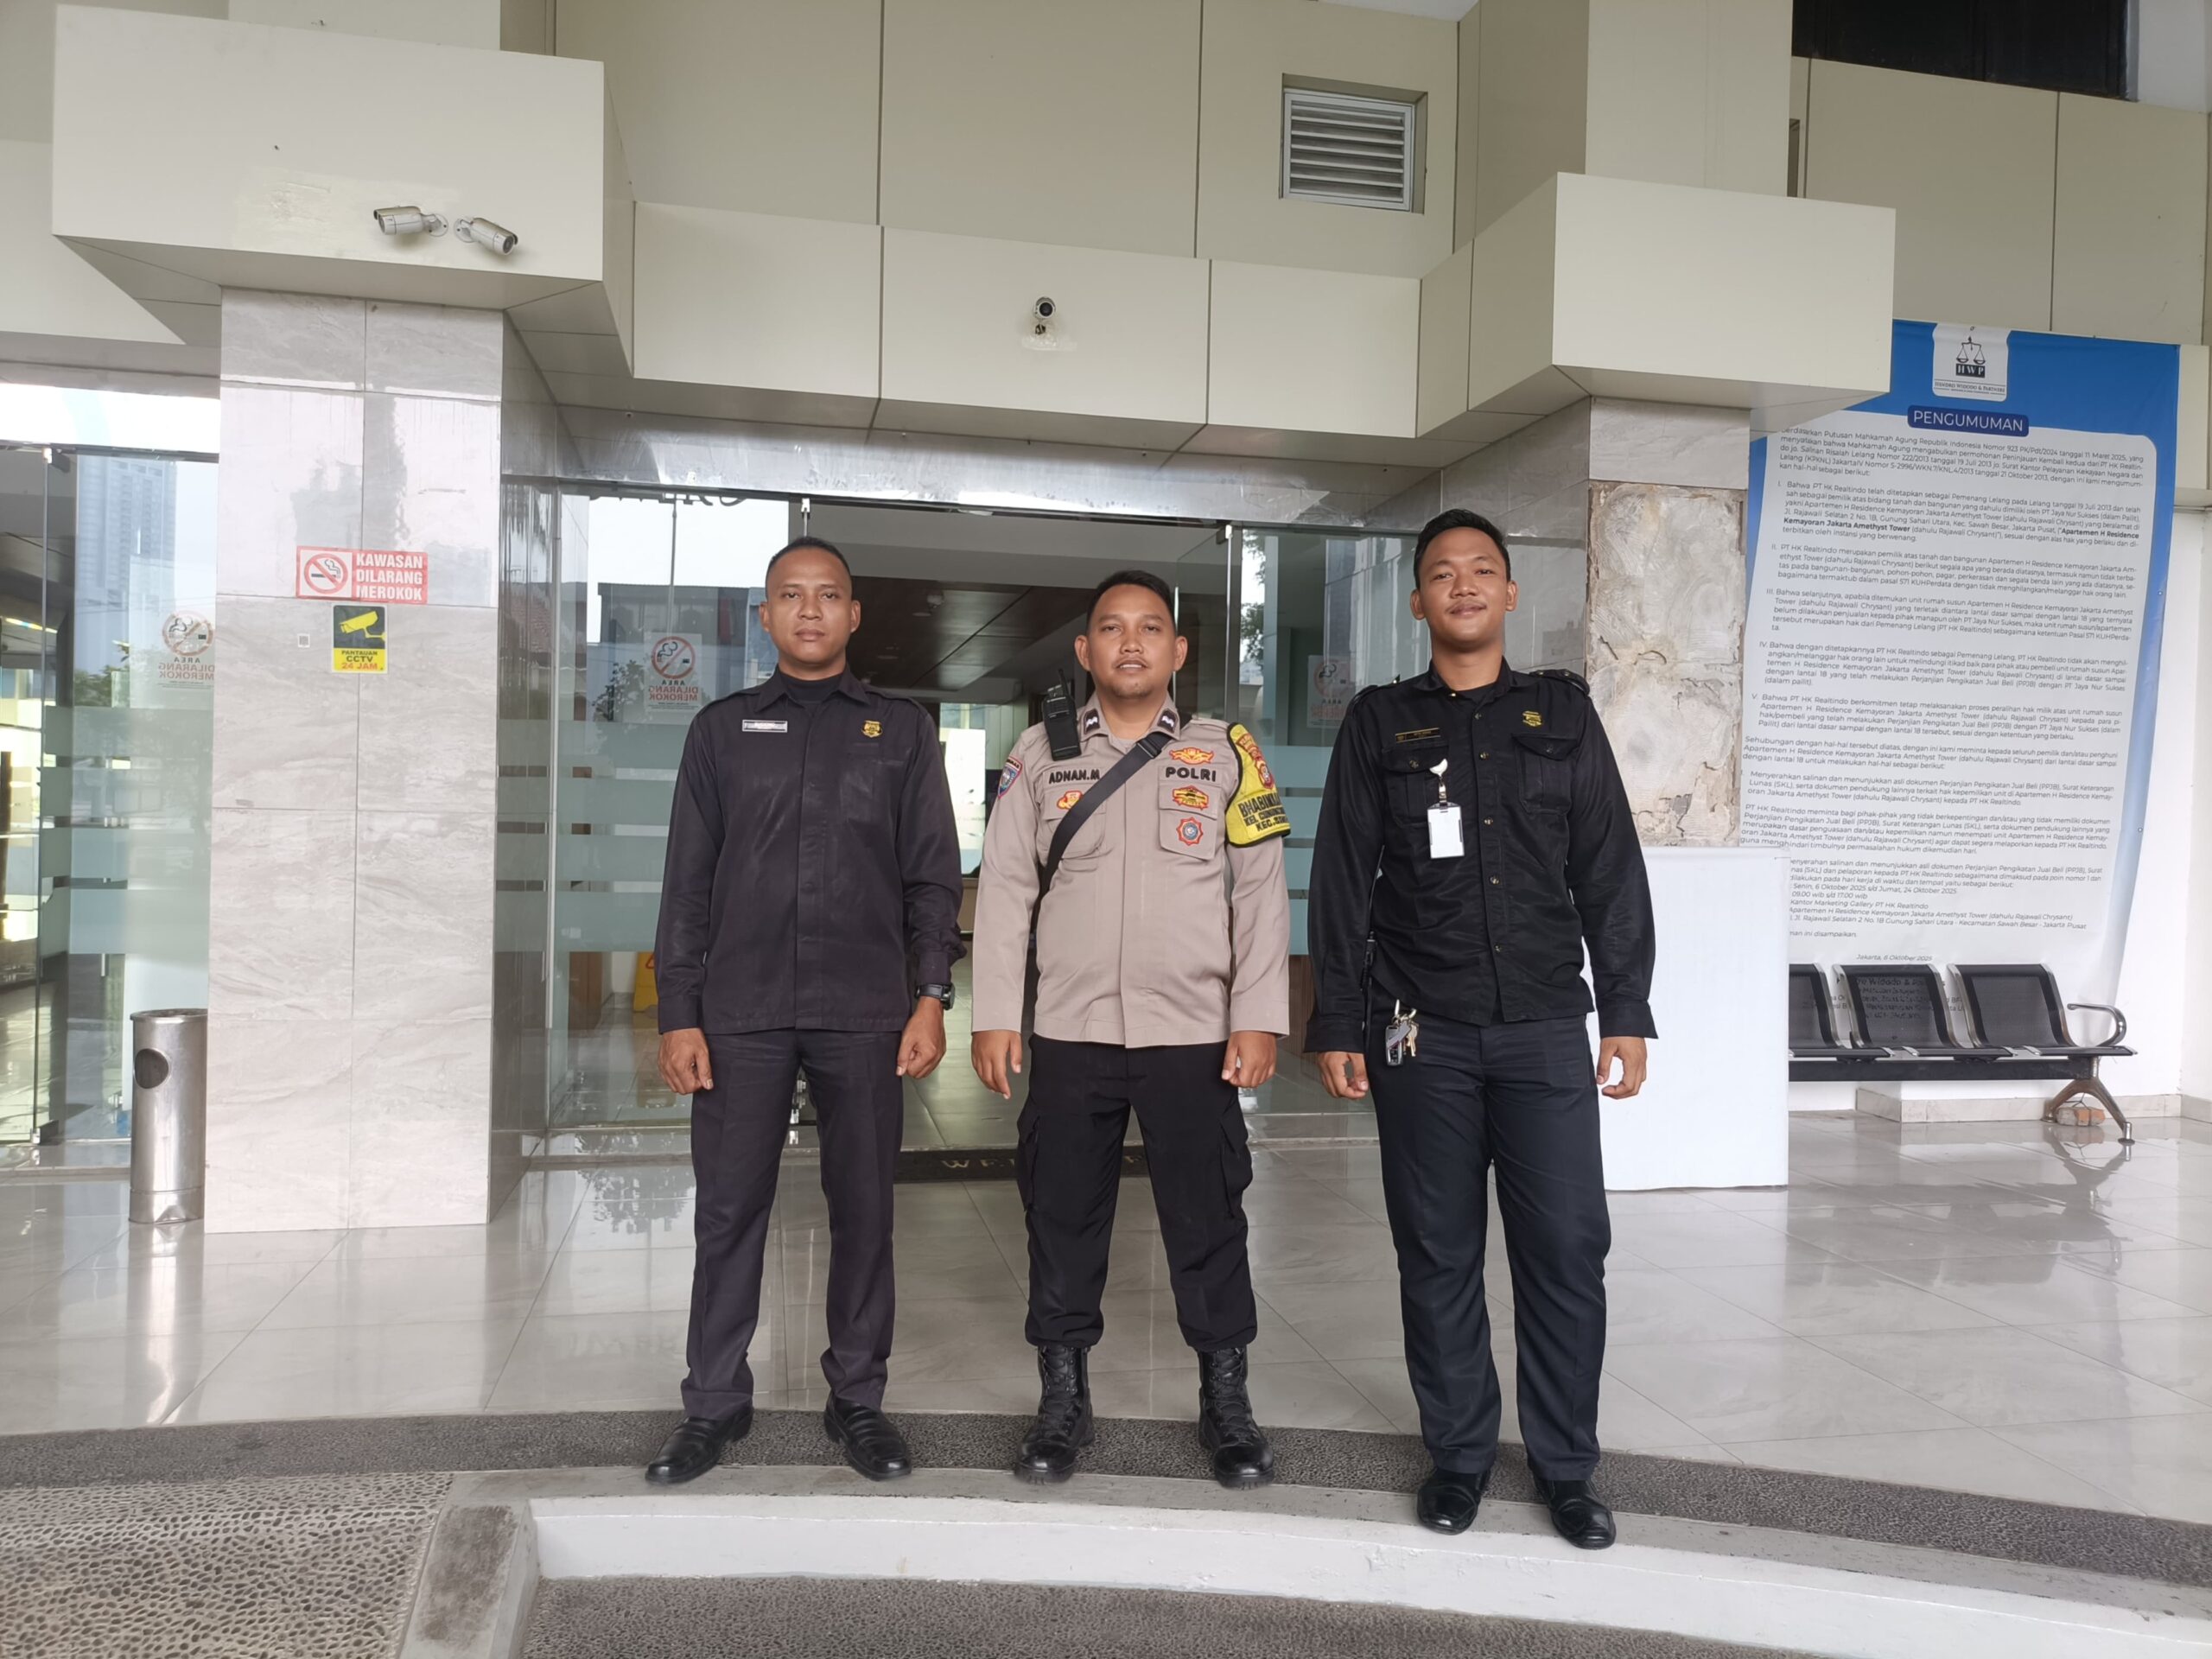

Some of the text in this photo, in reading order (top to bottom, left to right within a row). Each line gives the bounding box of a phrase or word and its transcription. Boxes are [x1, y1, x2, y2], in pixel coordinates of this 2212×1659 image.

[1958, 365, 1984, 375] HWP
[1913, 410, 2023, 432] PENGUMUMAN
[1888, 444, 1911, 452] Agung
[1912, 446, 1957, 456] mengabulkan
[1959, 450, 2001, 460] permohonan
[2002, 453, 2037, 463] Peninjauan
[2039, 456, 2064, 464] Kembali
[1818, 466, 1843, 475] sebagai
[1879, 516, 1907, 524] Gunung
[1784, 517, 1825, 527] Kemayoran
[1853, 522, 1887, 531] Amethyst
[2025, 534, 2049, 542] dengan
[356, 553, 423, 569] KAWASAN
[356, 569, 423, 585] DILARANG
[356, 585, 422, 601] MEROKOK
[2044, 604, 2078, 613] Kemayoran
[1048, 769, 1100, 785] ADNAN.M
[1166, 766, 1217, 782] POLRI
[1750, 771, 1801, 781] Menyerahkan
[1844, 776, 1892, 786] menunjukkan
[1974, 781, 2010, 790] Pengikatan
[1935, 813, 1988, 822] berkepentingan
[1814, 899, 1848, 908] Marketing
